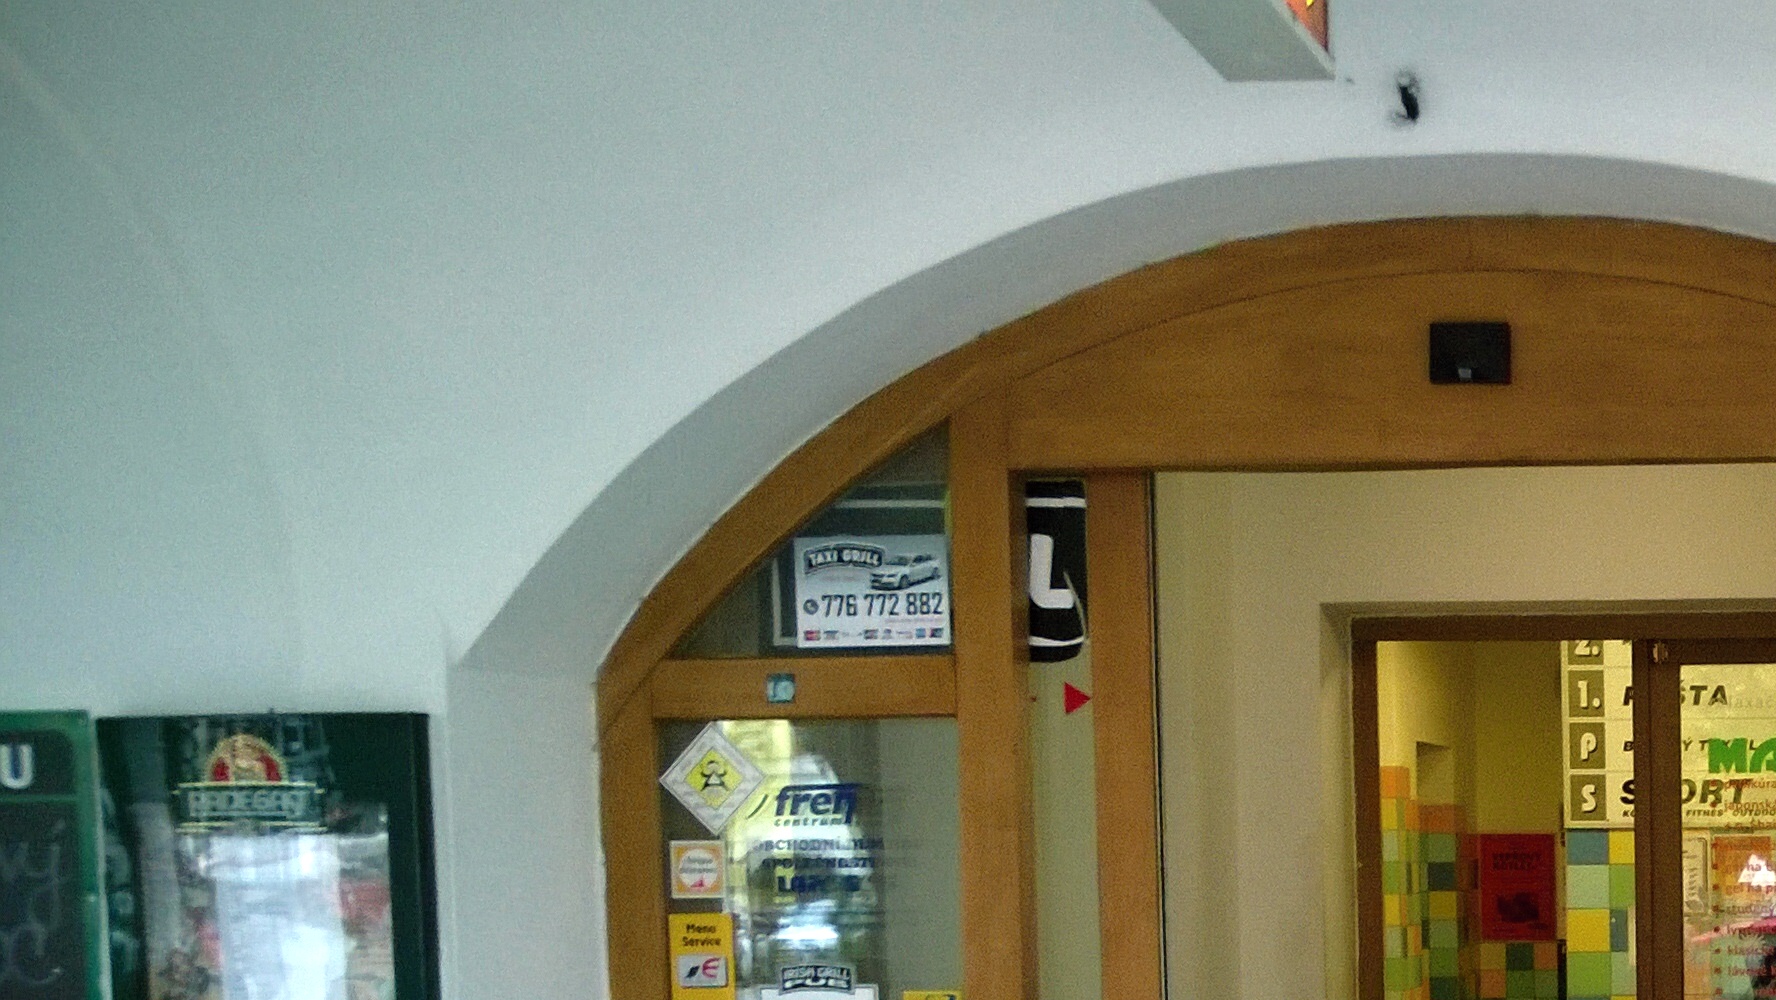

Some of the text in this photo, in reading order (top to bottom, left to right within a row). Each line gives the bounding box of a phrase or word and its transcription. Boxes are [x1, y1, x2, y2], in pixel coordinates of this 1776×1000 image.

[810, 550, 880, 566] TAXI GRILL
[822, 592, 943, 617] 776 772 882
[1578, 680, 1600, 708] 1.
[1580, 732, 1597, 761] P
[1582, 778, 1752, 812] S SORT
[774, 817, 842, 827] centrum
[683, 936, 721, 947] Service
